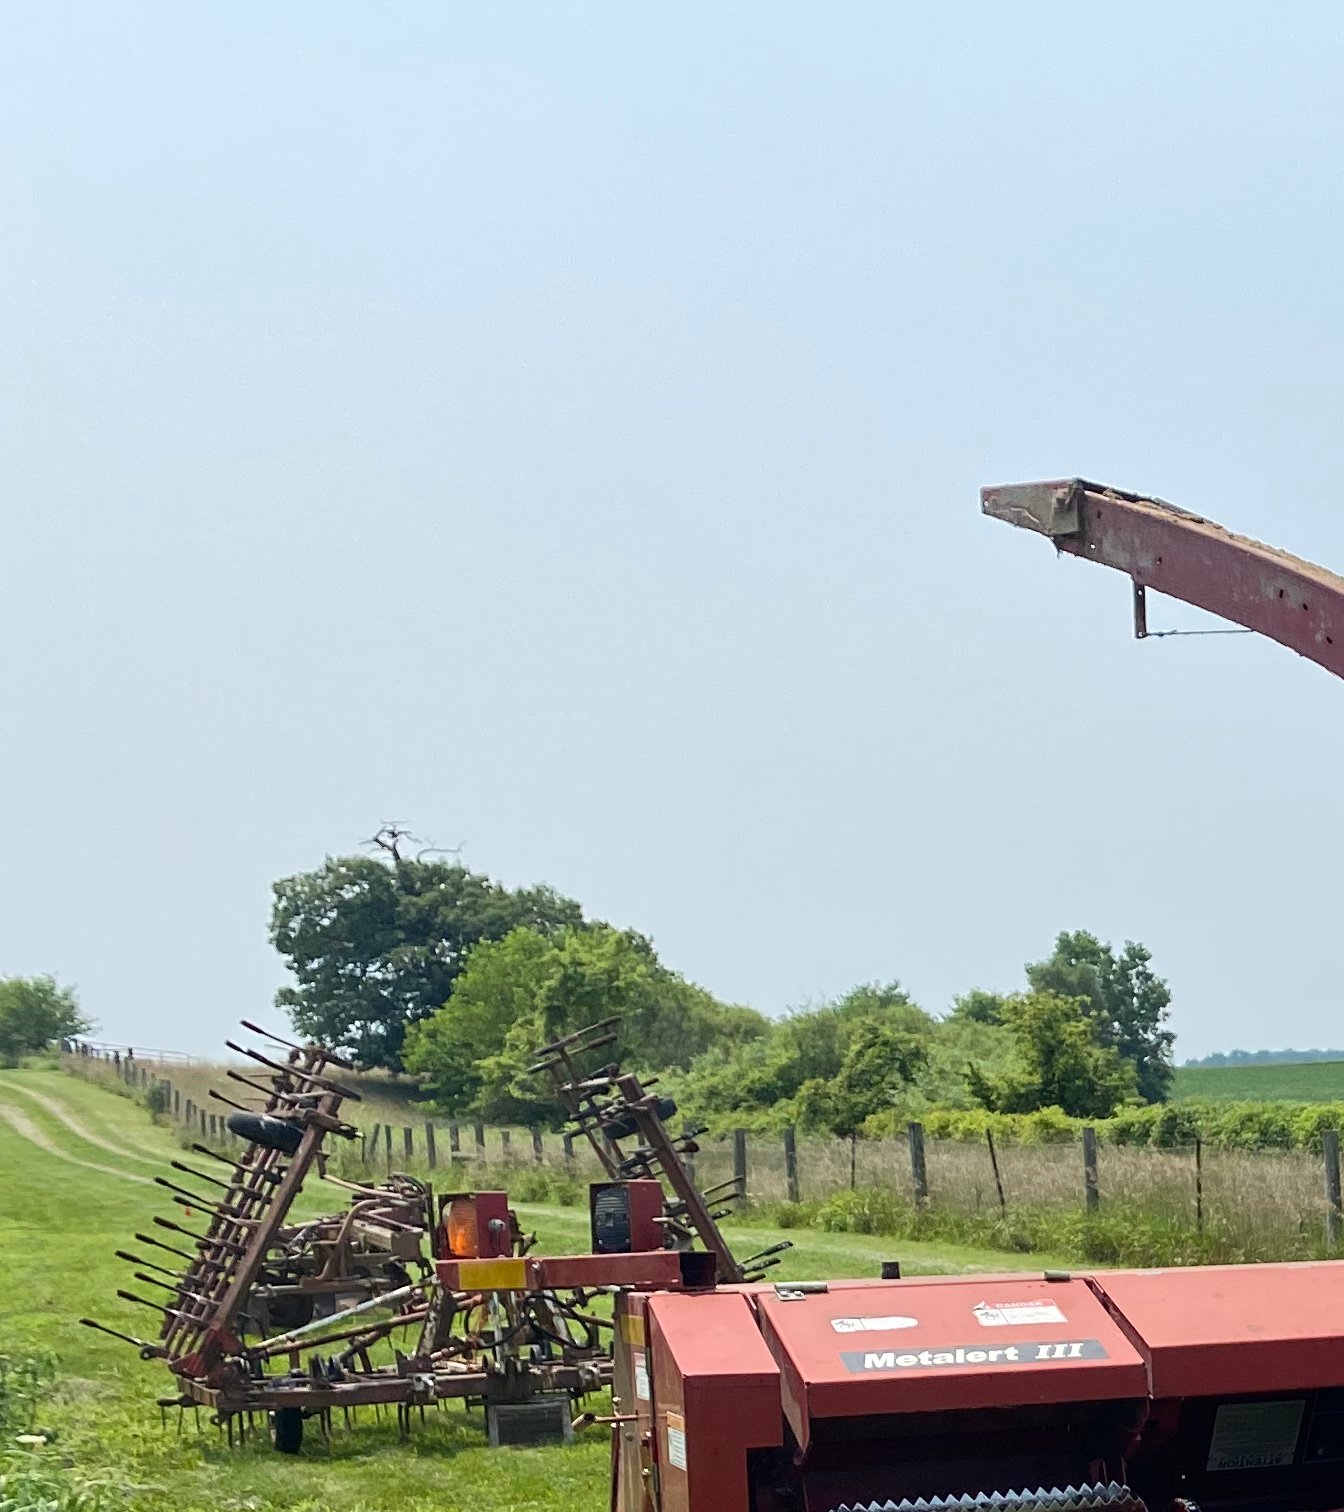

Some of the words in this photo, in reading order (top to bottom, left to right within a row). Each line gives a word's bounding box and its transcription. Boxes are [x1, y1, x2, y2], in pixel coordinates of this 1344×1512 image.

[863, 1346, 1020, 1369] Metalert
[1034, 1342, 1085, 1360] III
[1217, 1455, 1283, 1468] ATTENTION
